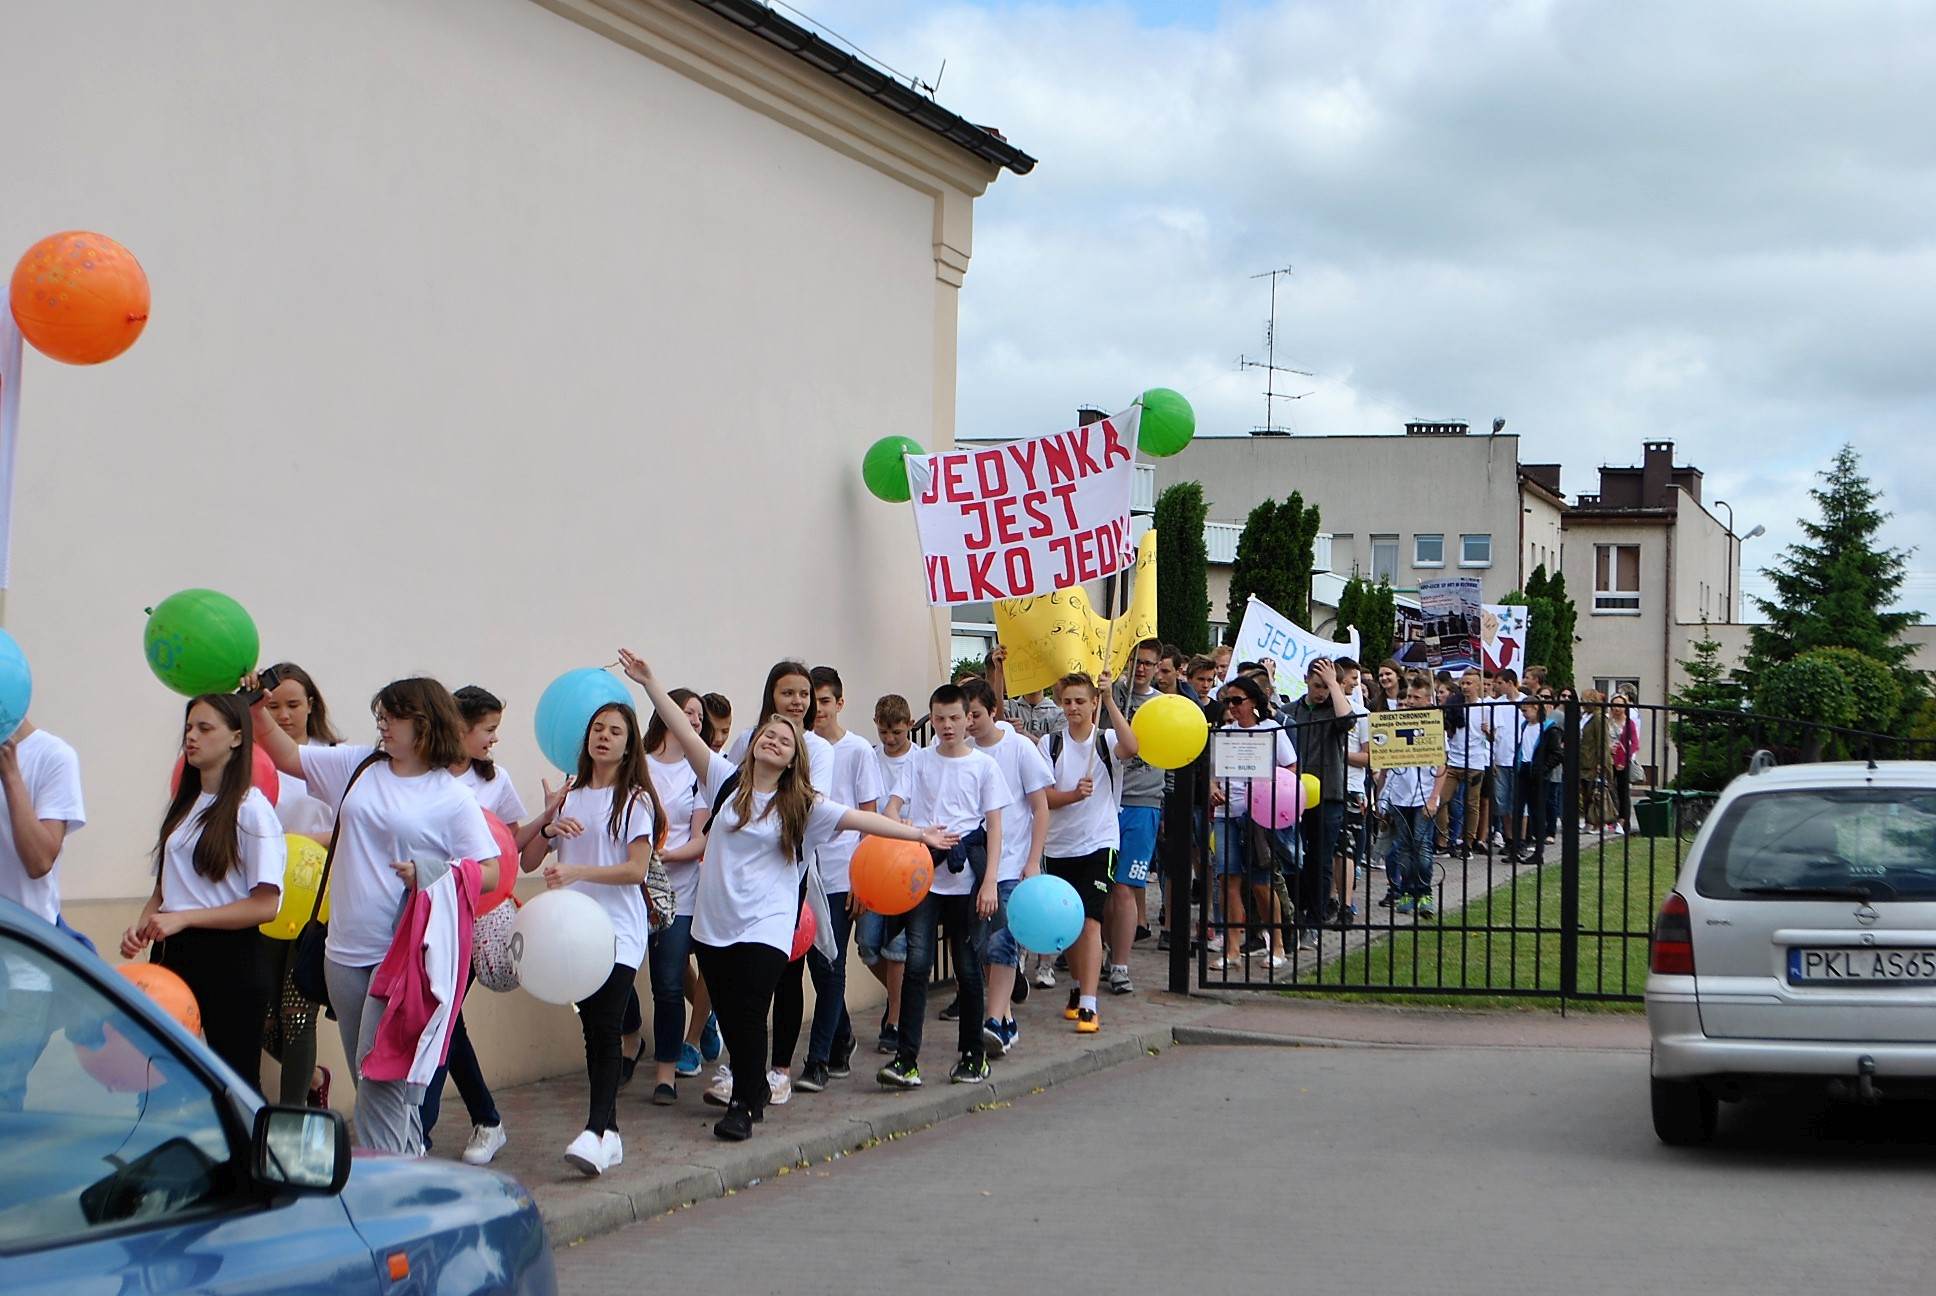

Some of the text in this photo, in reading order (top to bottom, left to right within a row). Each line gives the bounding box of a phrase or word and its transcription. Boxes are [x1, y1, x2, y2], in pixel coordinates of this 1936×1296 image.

[921, 420, 1131, 504] JEDYNKA
[961, 483, 1079, 550] JEST
[1128, 863, 1148, 881] 86
[1806, 952, 1936, 977] PKL AS65
